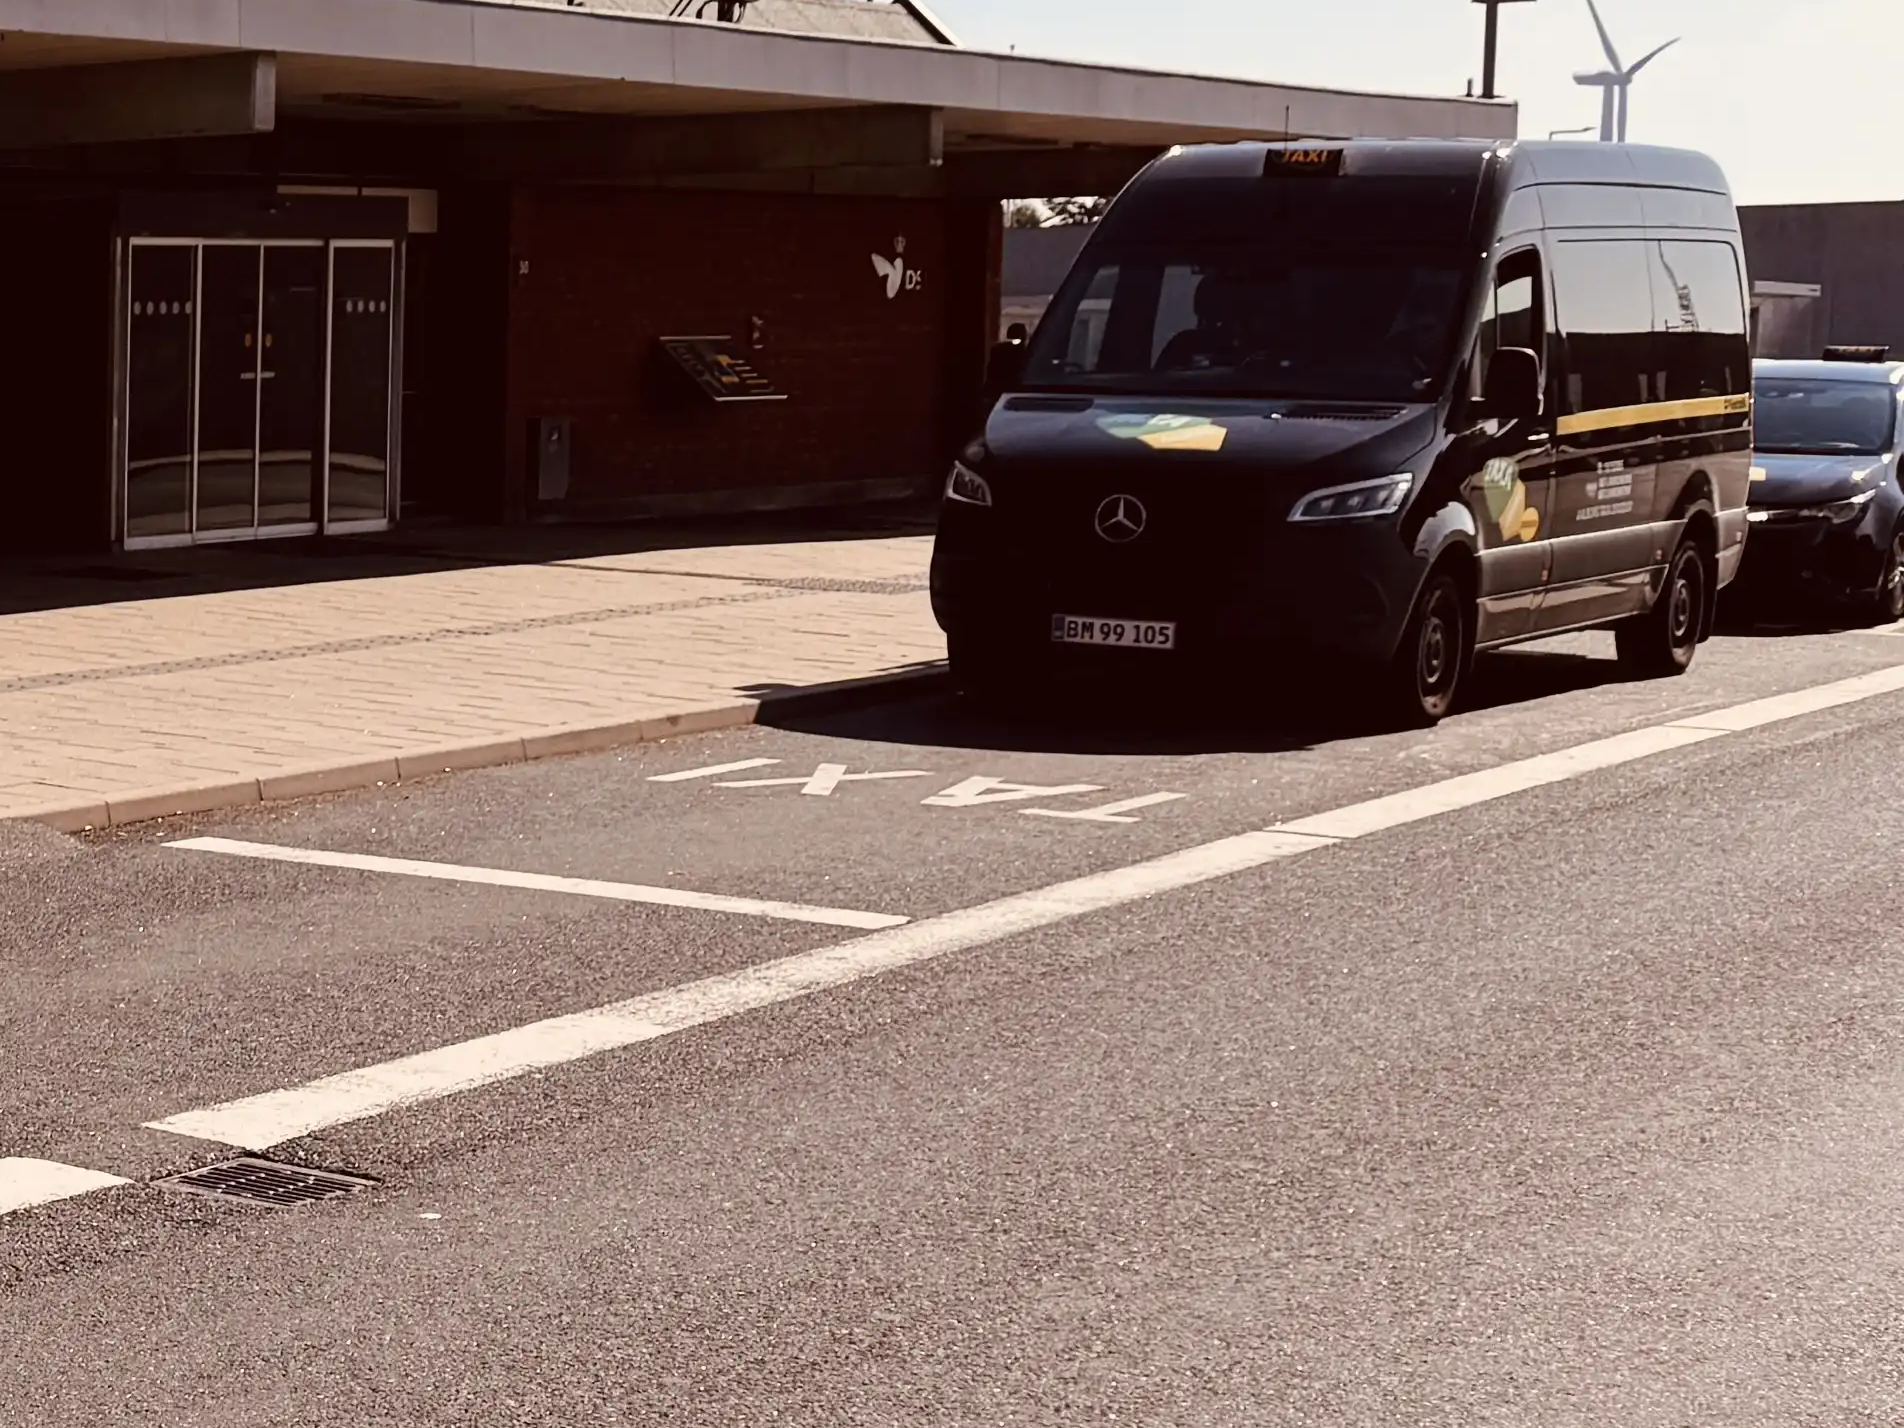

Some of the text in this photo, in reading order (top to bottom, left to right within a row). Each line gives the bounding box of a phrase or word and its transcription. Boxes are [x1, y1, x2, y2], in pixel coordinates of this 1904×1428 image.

[1066, 620, 1171, 645] BM 99 105
[645, 758, 1188, 823] TAXI
